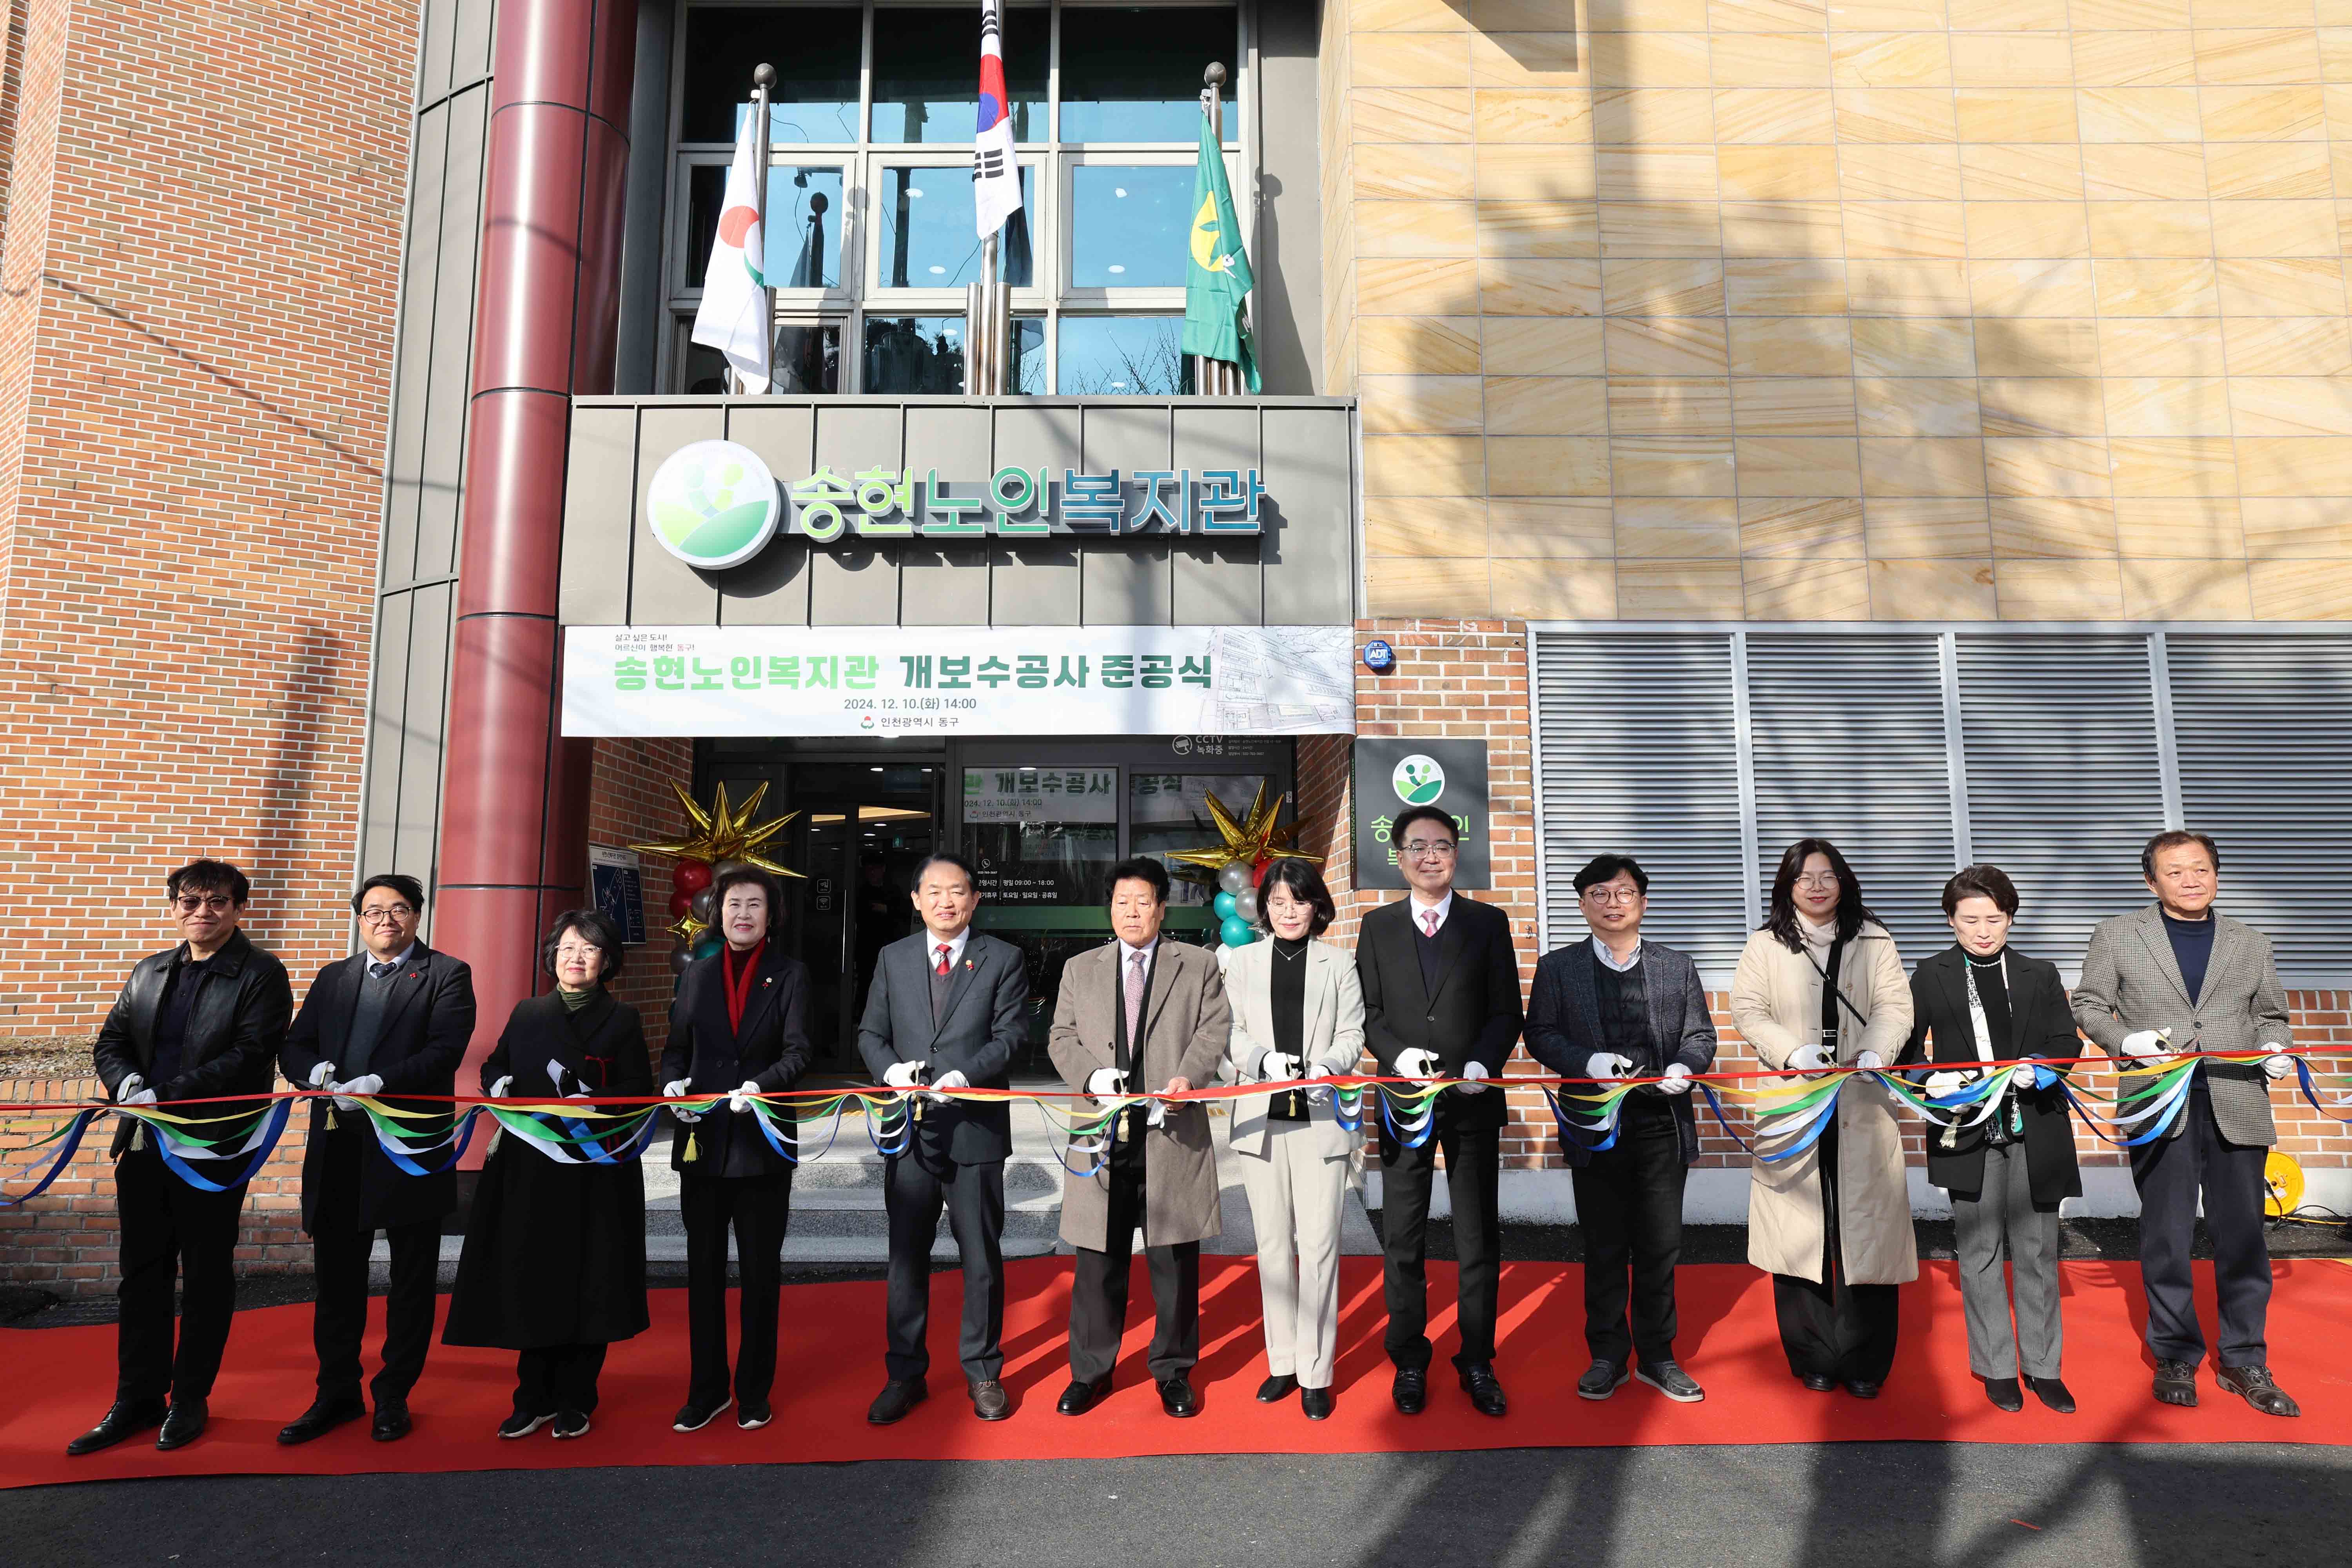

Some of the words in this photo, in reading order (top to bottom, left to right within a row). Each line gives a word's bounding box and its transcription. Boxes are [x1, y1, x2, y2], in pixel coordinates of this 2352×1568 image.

[791, 464, 1266, 544] 송현노인복지관
[1370, 649, 1387, 659] ADT
[614, 656, 879, 690] 송현노인복지관
[899, 655, 1089, 689] 개보수공사
[1101, 655, 1212, 688] 준공식
[844, 699, 877, 709] 2024.
[882, 699, 898, 709] 12.
[903, 698, 940, 710] 10.(화)
[944, 699, 976, 709] 14:00
[881, 717, 933, 727] 인천광역시
[938, 717, 959, 727] 동구
[1196, 745, 1223, 755] 녹화중
